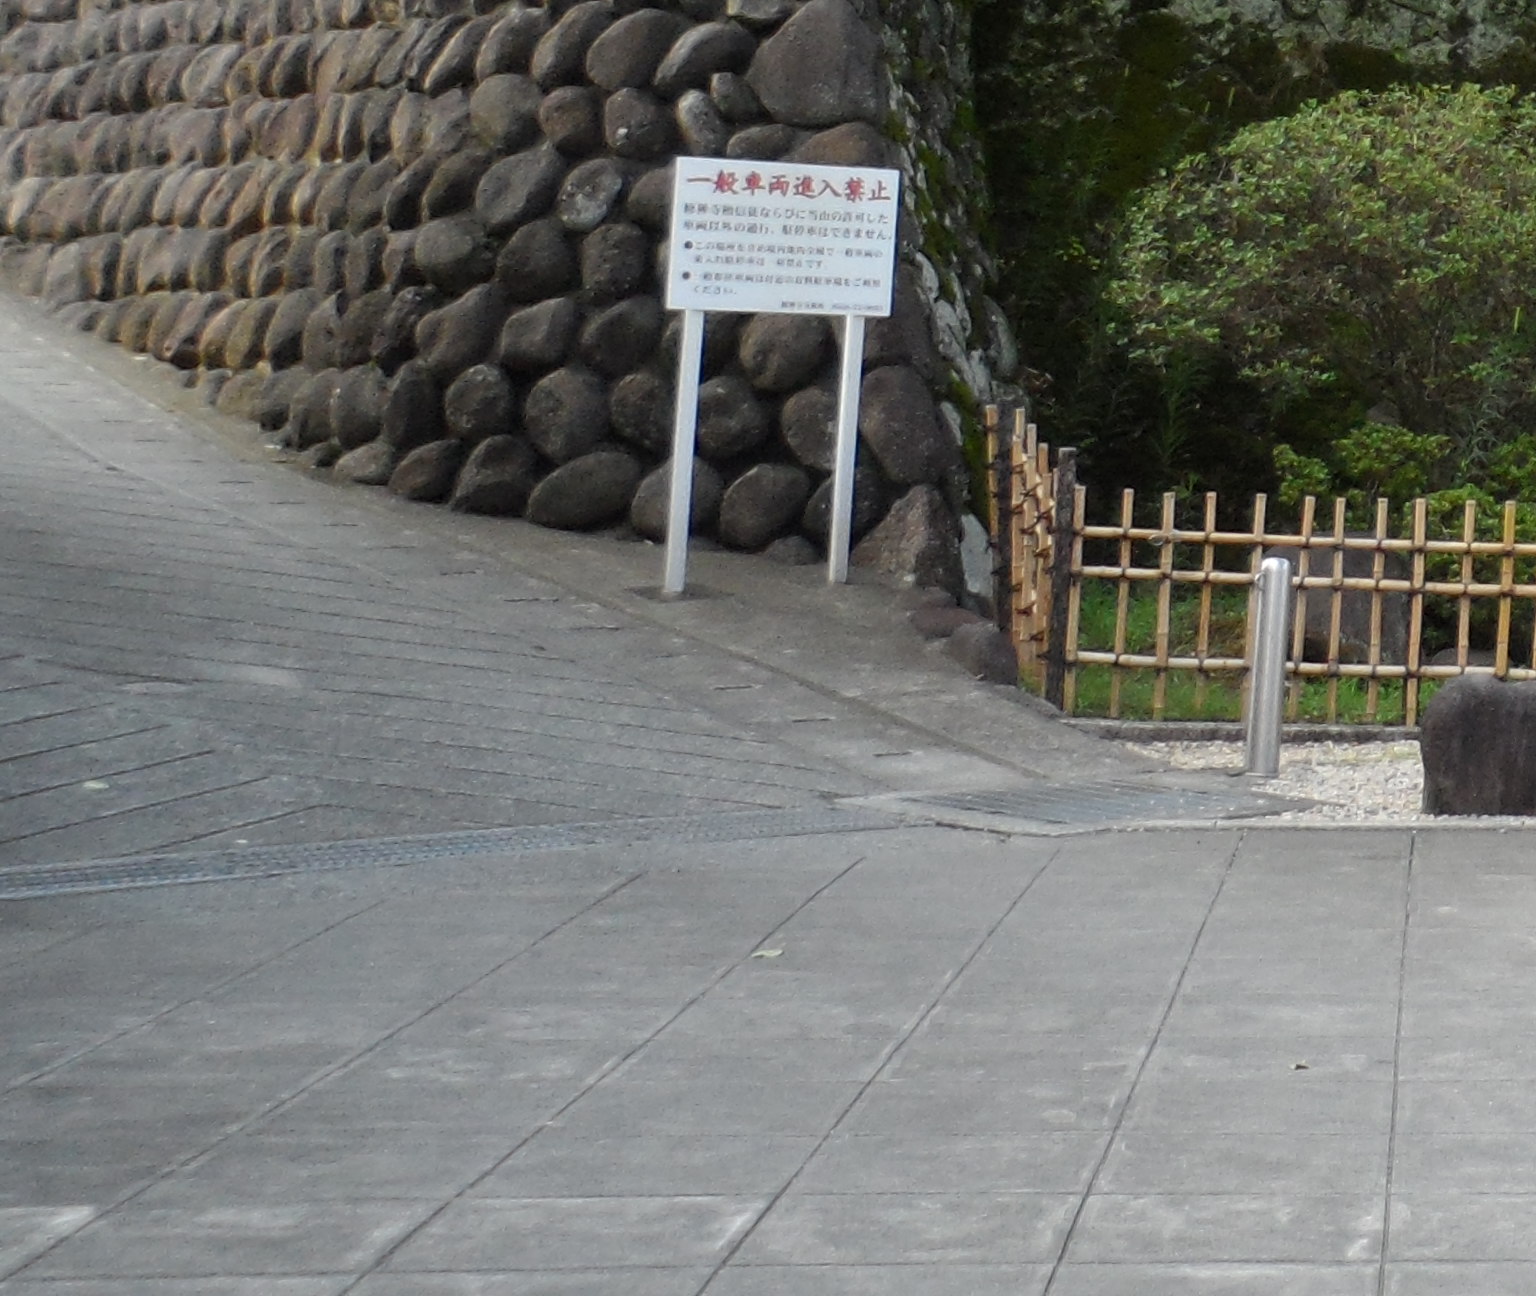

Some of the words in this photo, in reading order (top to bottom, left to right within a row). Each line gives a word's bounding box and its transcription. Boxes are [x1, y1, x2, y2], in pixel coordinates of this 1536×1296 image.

[687, 168, 892, 203] 一般車両進入禁止
